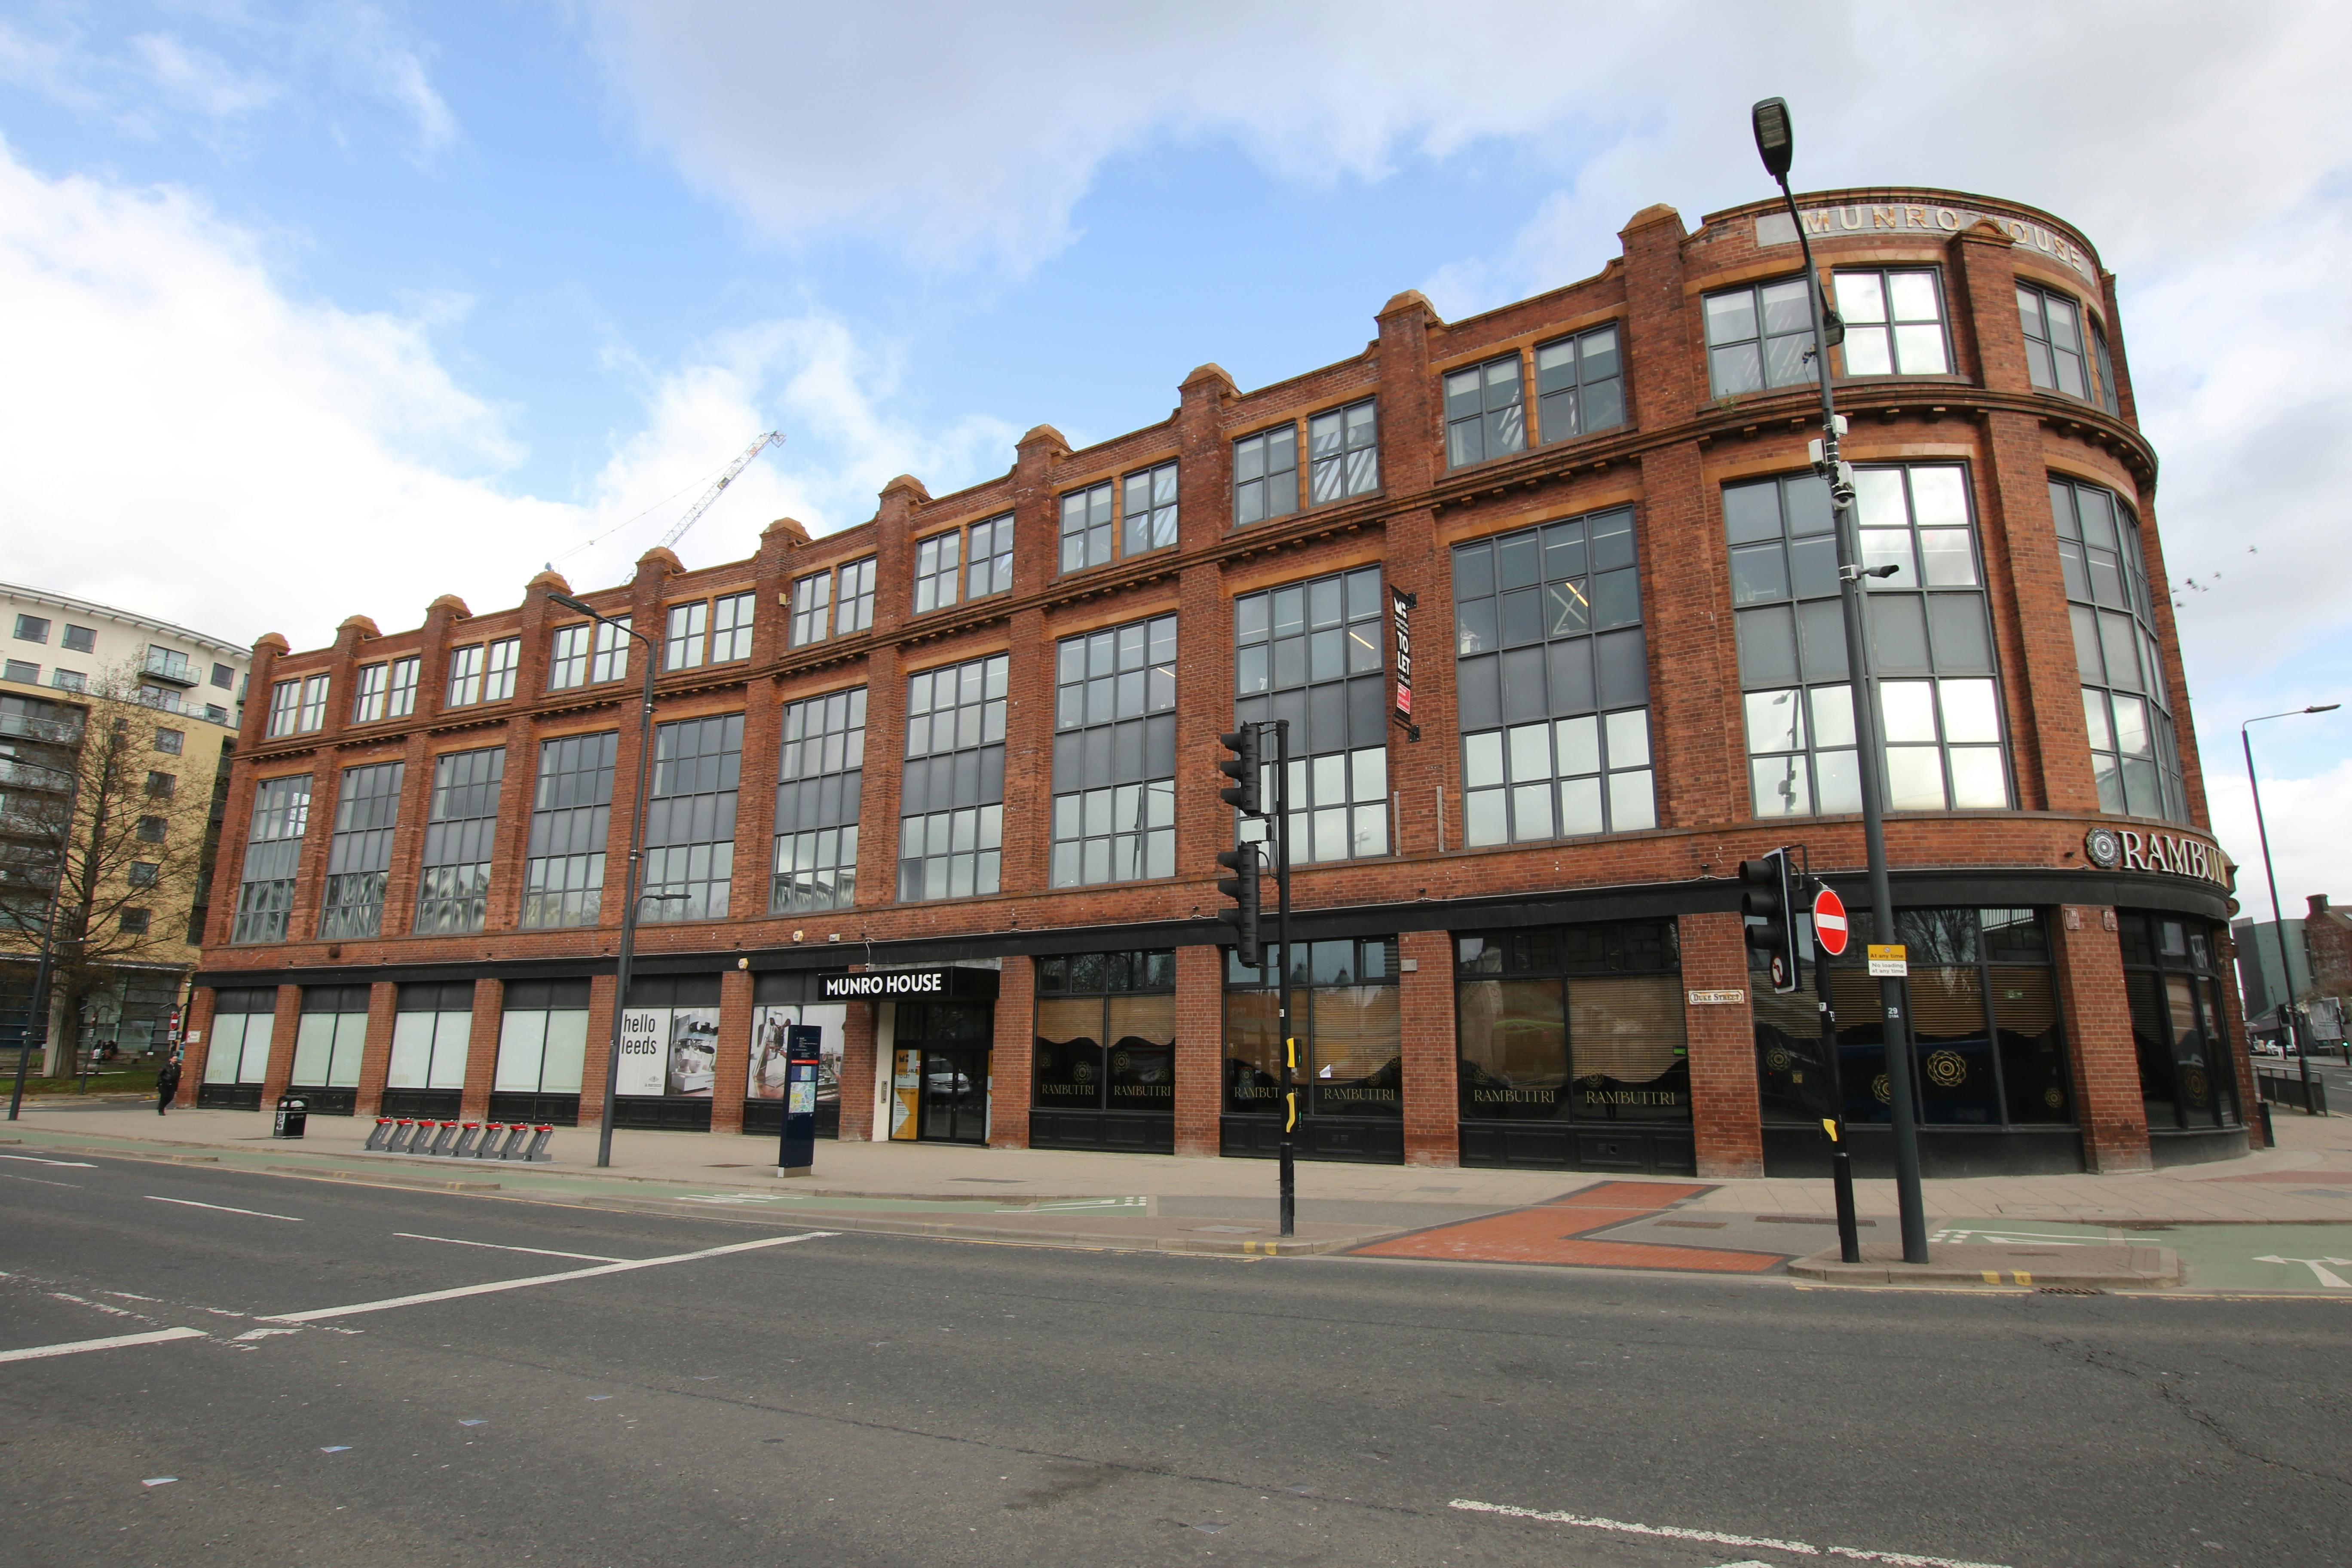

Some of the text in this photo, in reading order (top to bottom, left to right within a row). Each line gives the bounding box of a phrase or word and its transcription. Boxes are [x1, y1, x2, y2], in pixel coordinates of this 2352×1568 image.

[1800, 205, 2083, 273] MUNRO OUSE
[1397, 631, 1409, 654] TO
[1397, 651, 1410, 675] LET
[827, 973, 942, 996] MUNRO HOUSE
[623, 1014, 656, 1033] hello
[621, 1036, 657, 1055] leeds
[1042, 1084, 1094, 1096] RAMBUTTRI
[1114, 1085, 1171, 1097] RAMBUTTRI
[1324, 1088, 1394, 1101] RAMBUTTRI
[1474, 1089, 1555, 1103] RAMBUTTRI
[1586, 1090, 1676, 1106] RAMBUTTRI
